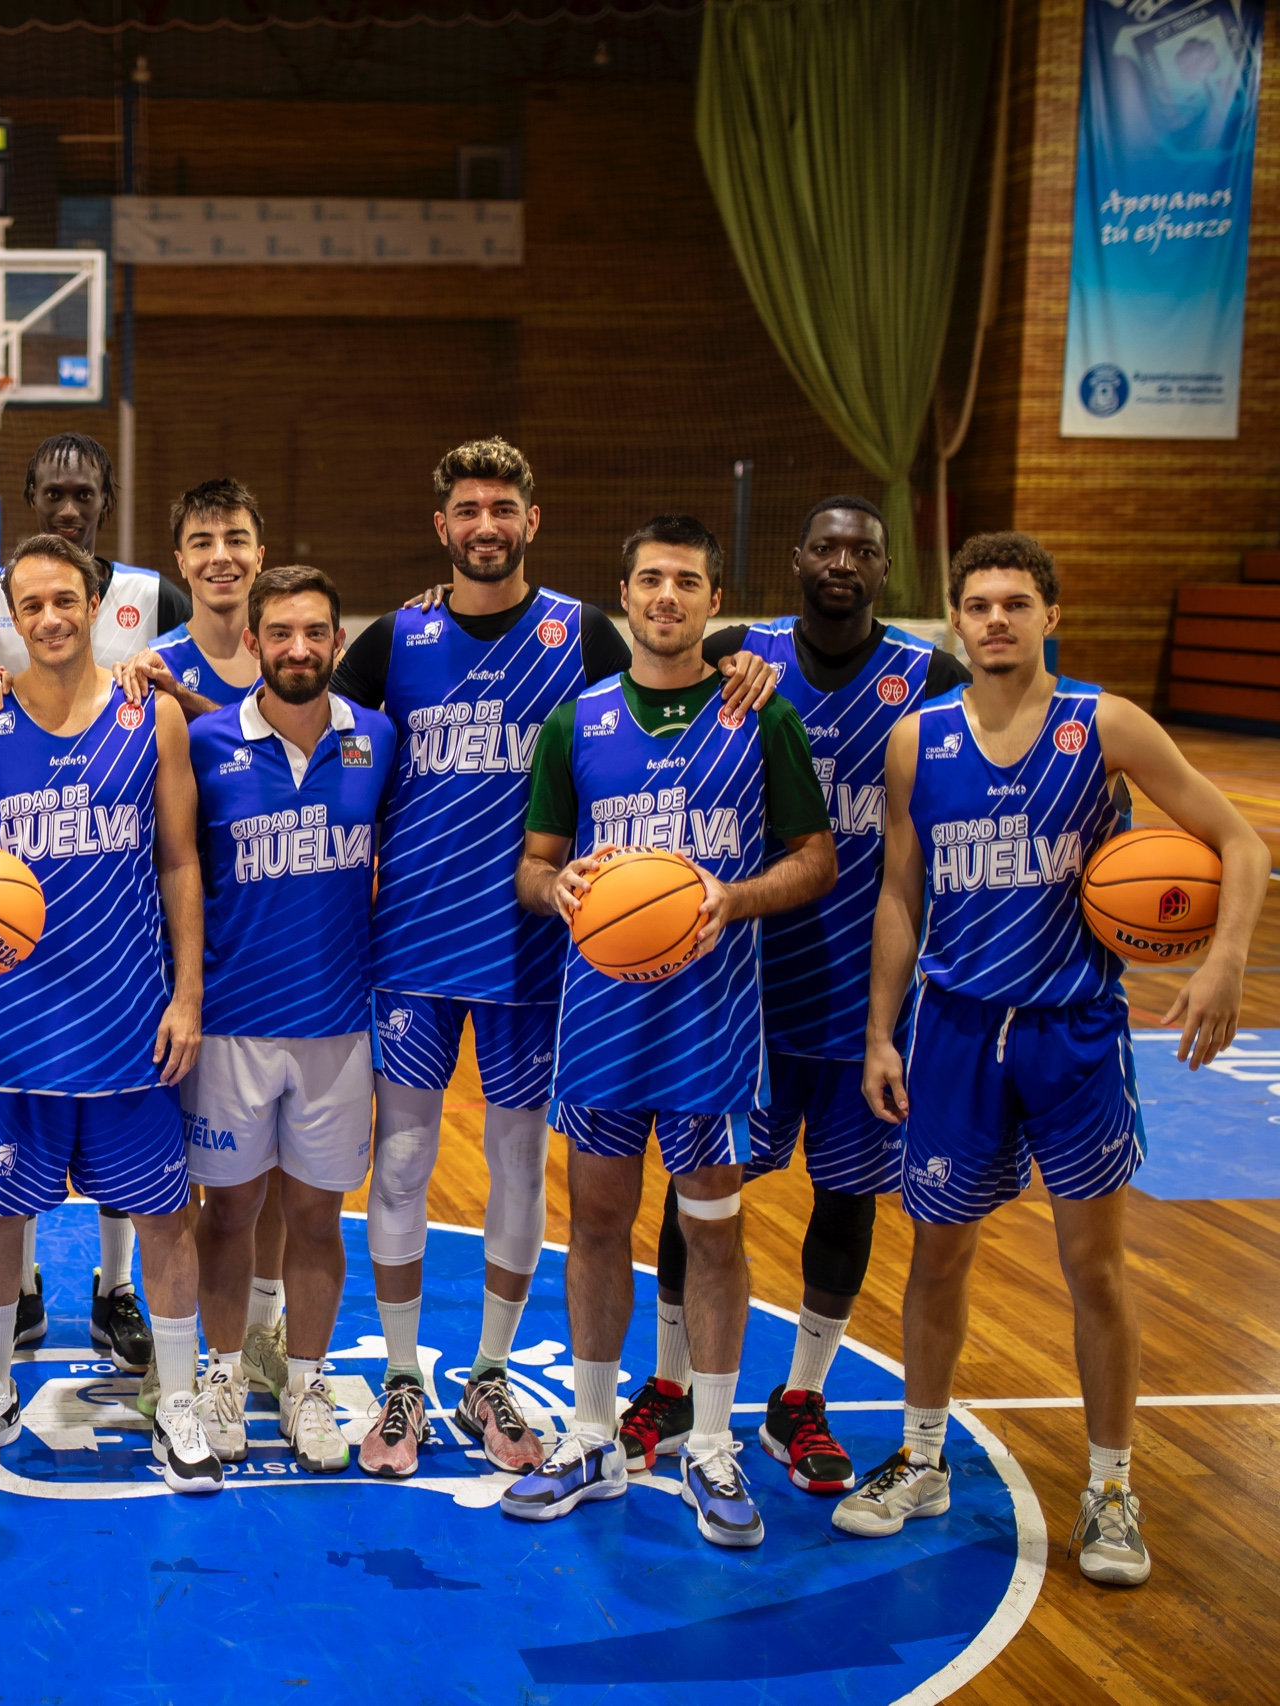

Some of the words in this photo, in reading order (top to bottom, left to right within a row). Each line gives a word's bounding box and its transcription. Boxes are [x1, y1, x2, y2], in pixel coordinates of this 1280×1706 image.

[1100, 188, 1232, 229] Apoyamos
[1101, 222, 1129, 246] tu
[1133, 214, 1232, 256] esfuerzo
[408, 701, 472, 732] CIUDAD
[474, 699, 504, 724] DE
[49, 755, 76, 767] besten
[220, 760, 241, 769] CIUDAD
[343, 750, 361, 758] LEB
[406, 723, 544, 779] HUELV
[646, 757, 675, 770] besten
[228, 765, 251, 773] HUELVA
[0, 788, 60, 820] CIUDAD
[62, 783, 89, 807] DE
[591, 792, 655, 822] CIUDAD
[658, 786, 686, 812] DE
[987, 785, 1015, 796] besten
[230, 810, 299, 840] CIUDAD
[300, 804, 327, 827] DE
[932, 818, 996, 847] CIUDAD
[999, 814, 1029, 840] DE
[235, 824, 371, 884] HUELVA
[932, 831, 1083, 895] HUELVA
[619, 941, 699, 981] Wilso
[184, 1120, 237, 1151] UELVA
[909, 1165, 934, 1179] CIUDAD
[916, 1176, 945, 1189] HUELVA
